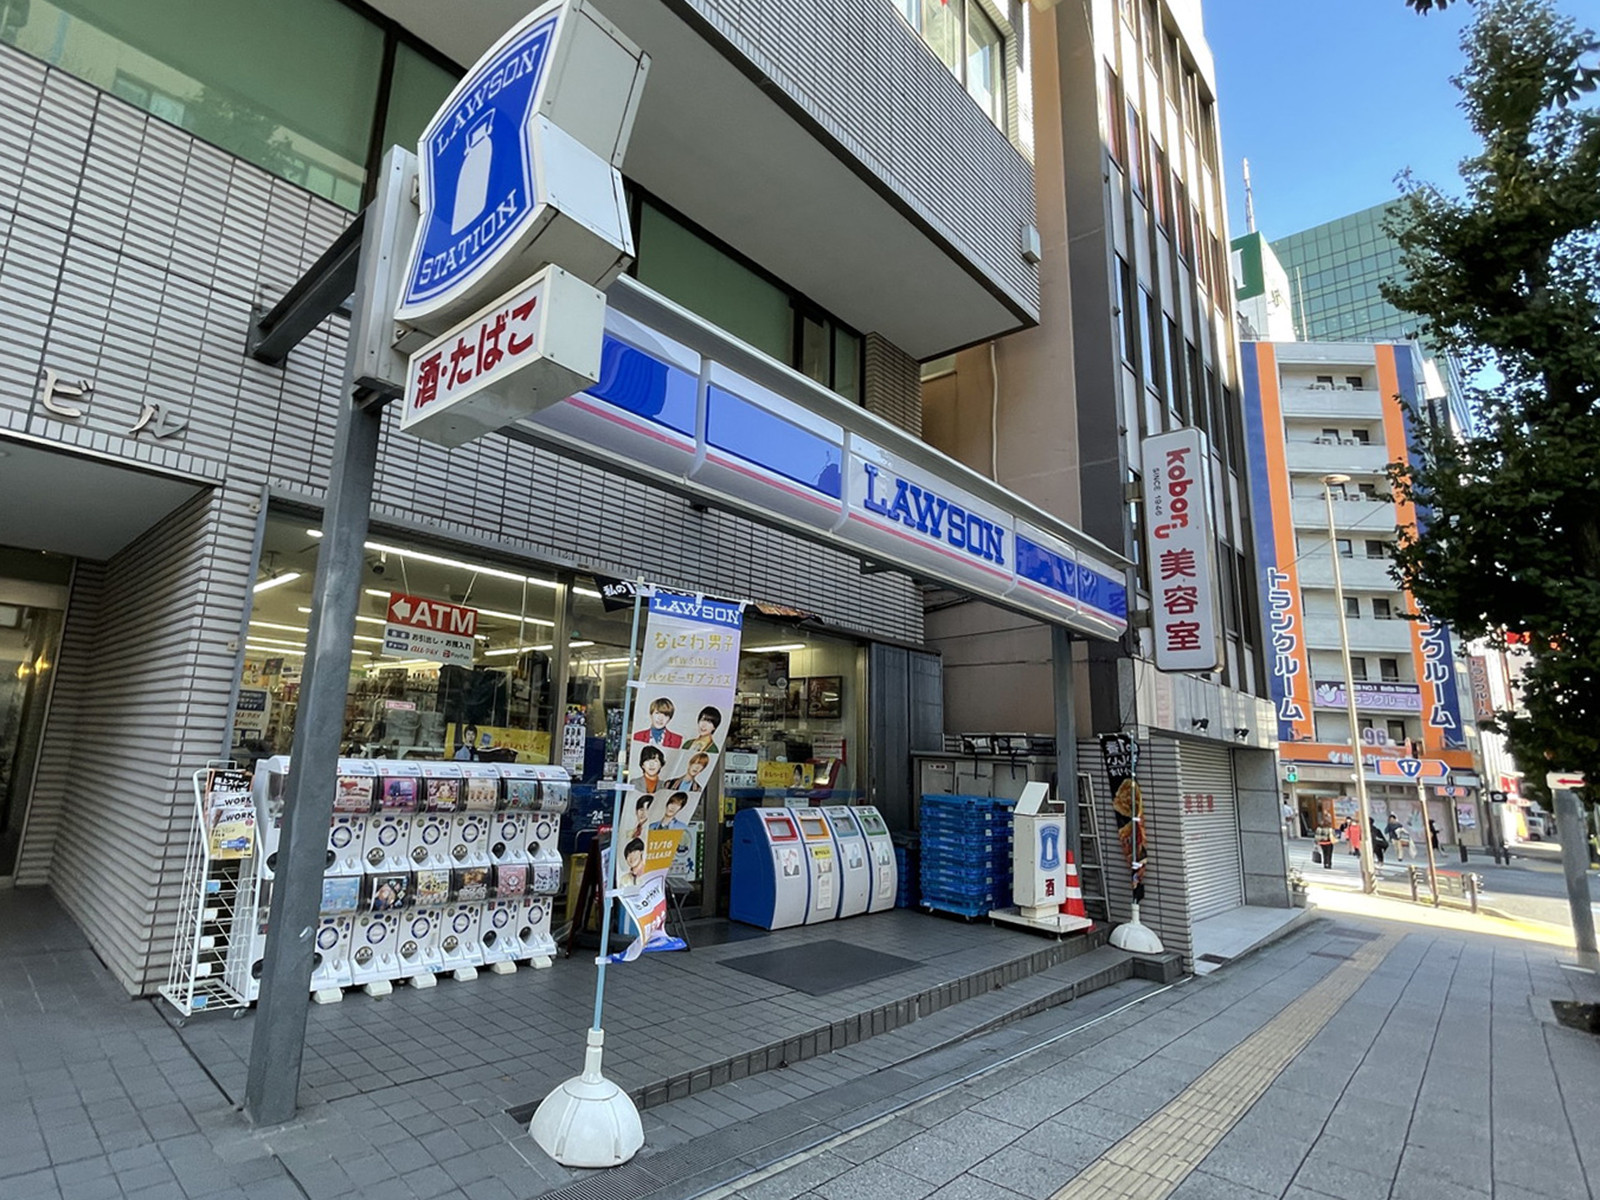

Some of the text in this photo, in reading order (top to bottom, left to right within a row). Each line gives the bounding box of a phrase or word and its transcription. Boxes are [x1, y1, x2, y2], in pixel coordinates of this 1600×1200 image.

[436, 43, 540, 157] LAWSON
[418, 188, 518, 286] STATION
[413, 295, 537, 409] 酒・たばこ
[42, 366, 190, 439] ビル
[1152, 467, 1161, 492] SINCE
[863, 462, 1005, 565] LAWSON
[654, 597, 740, 626] LAWSON
[1159, 547, 1202, 652] 美容室
[410, 601, 476, 635] ATM
[653, 631, 734, 652] なにわ男子
[1267, 566, 1306, 721] トランクルーム
[1415, 597, 1456, 728] ンクルーム
[1364, 728, 1388, 746] 96
[1401, 761, 1418, 774] 17
[224, 796, 252, 806] WORK
[226, 811, 254, 822] WORK
[592, 810, 604, 820] 24
[650, 840, 673, 850] 11/16
